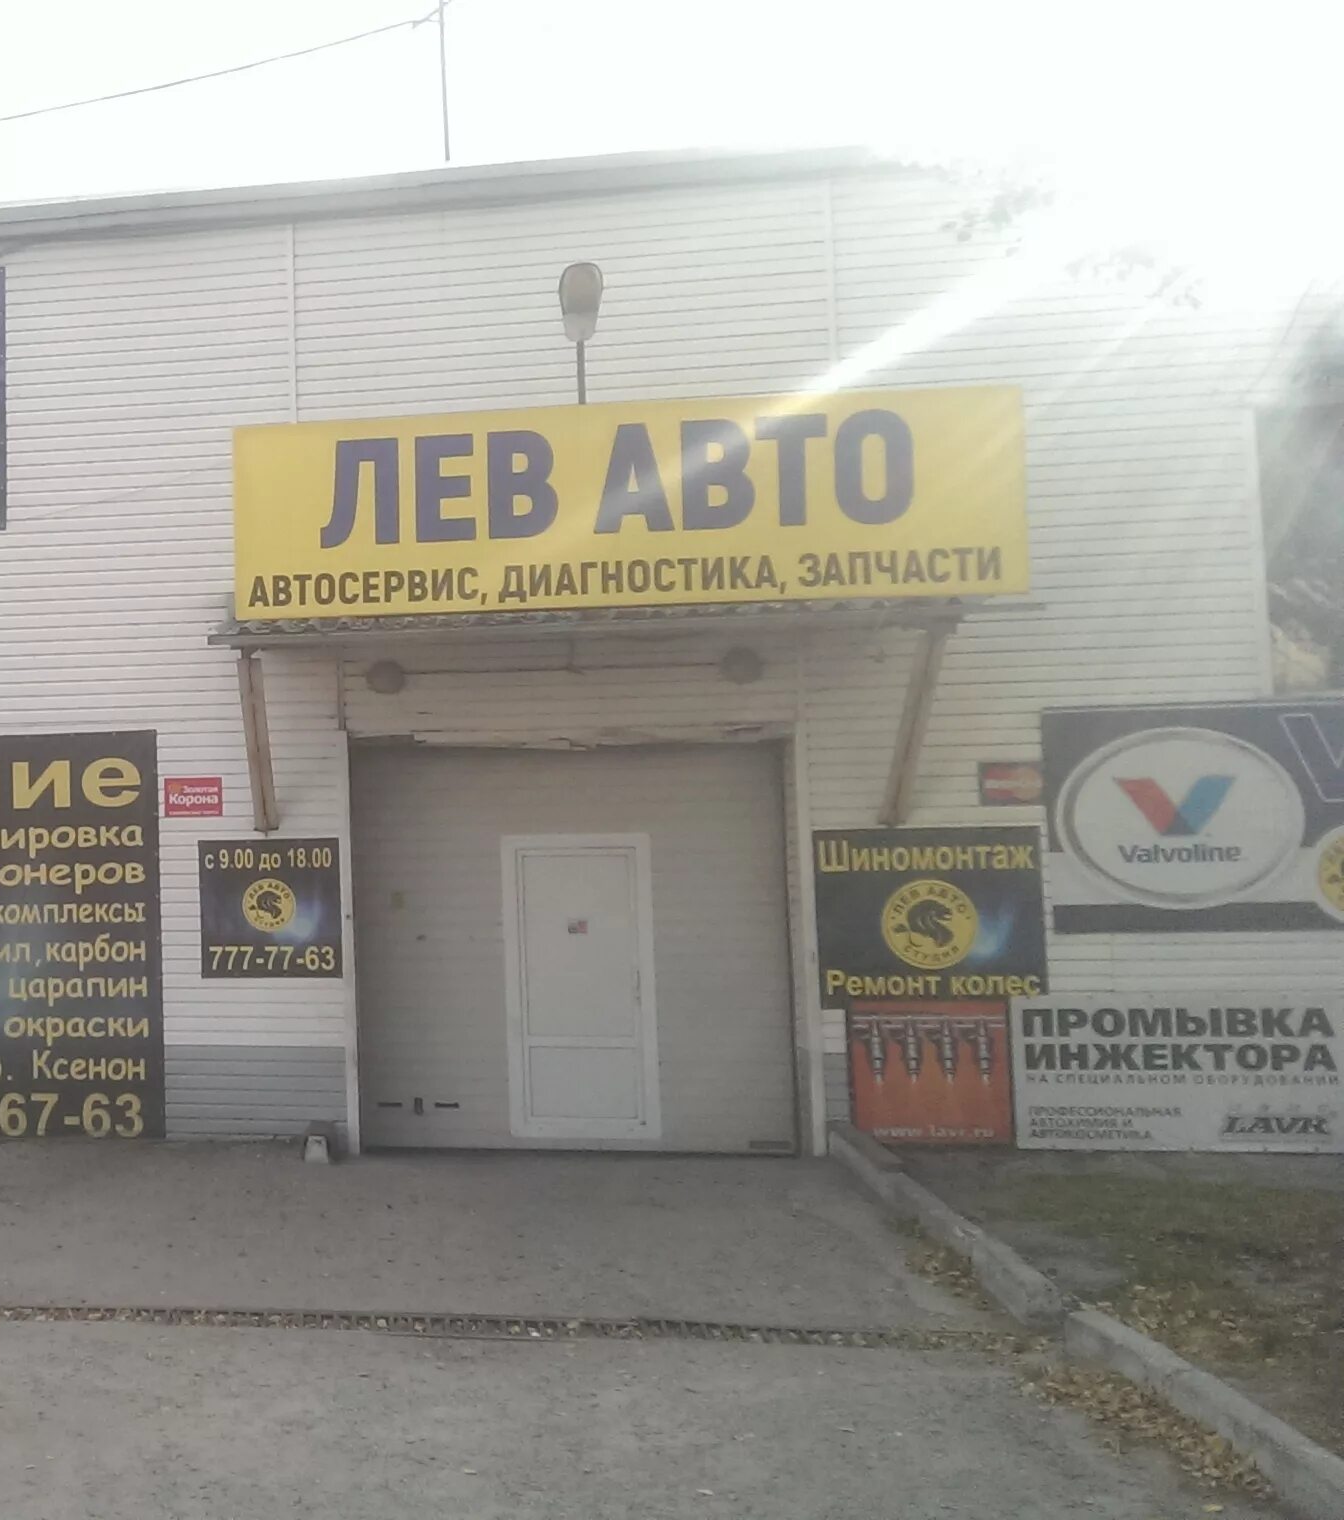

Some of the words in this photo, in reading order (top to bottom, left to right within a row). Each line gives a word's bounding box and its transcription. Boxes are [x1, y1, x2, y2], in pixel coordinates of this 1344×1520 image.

[320, 429, 559, 549] ЛЕВ
[593, 407, 916, 536] АВТО
[249, 566, 487, 608] АВТОСЕРВИС,
[499, 555, 788, 601] ДИАГНОСТИКА,
[797, 546, 1002, 589] ЗАПЧАСТИ
[169, 793, 219, 807] Корона
[219, 848, 254, 869] 9.00
[259, 853, 281, 871] до
[287, 847, 332, 868] 18.00
[819, 839, 1035, 873] Шиномонтаж
[1117, 844, 1243, 864] Valvoline
[209, 945, 335, 970] 777-77-63
[8, 976, 148, 1007] царапин
[826, 969, 942, 996] Ремонт
[952, 975, 1040, 997] колес
[4, 1016, 149, 1046] окраски
[1022, 1007, 1336, 1038] ПРОМЫВКА
[32, 1049, 146, 1081] Ксенон
[1024, 1043, 1338, 1072] ИНЖЕКТОРА
[1056, 1073, 1187, 1086] СПЕЦИАЛЬНОМ
[1223, 1116, 1330, 1134] LAVR
